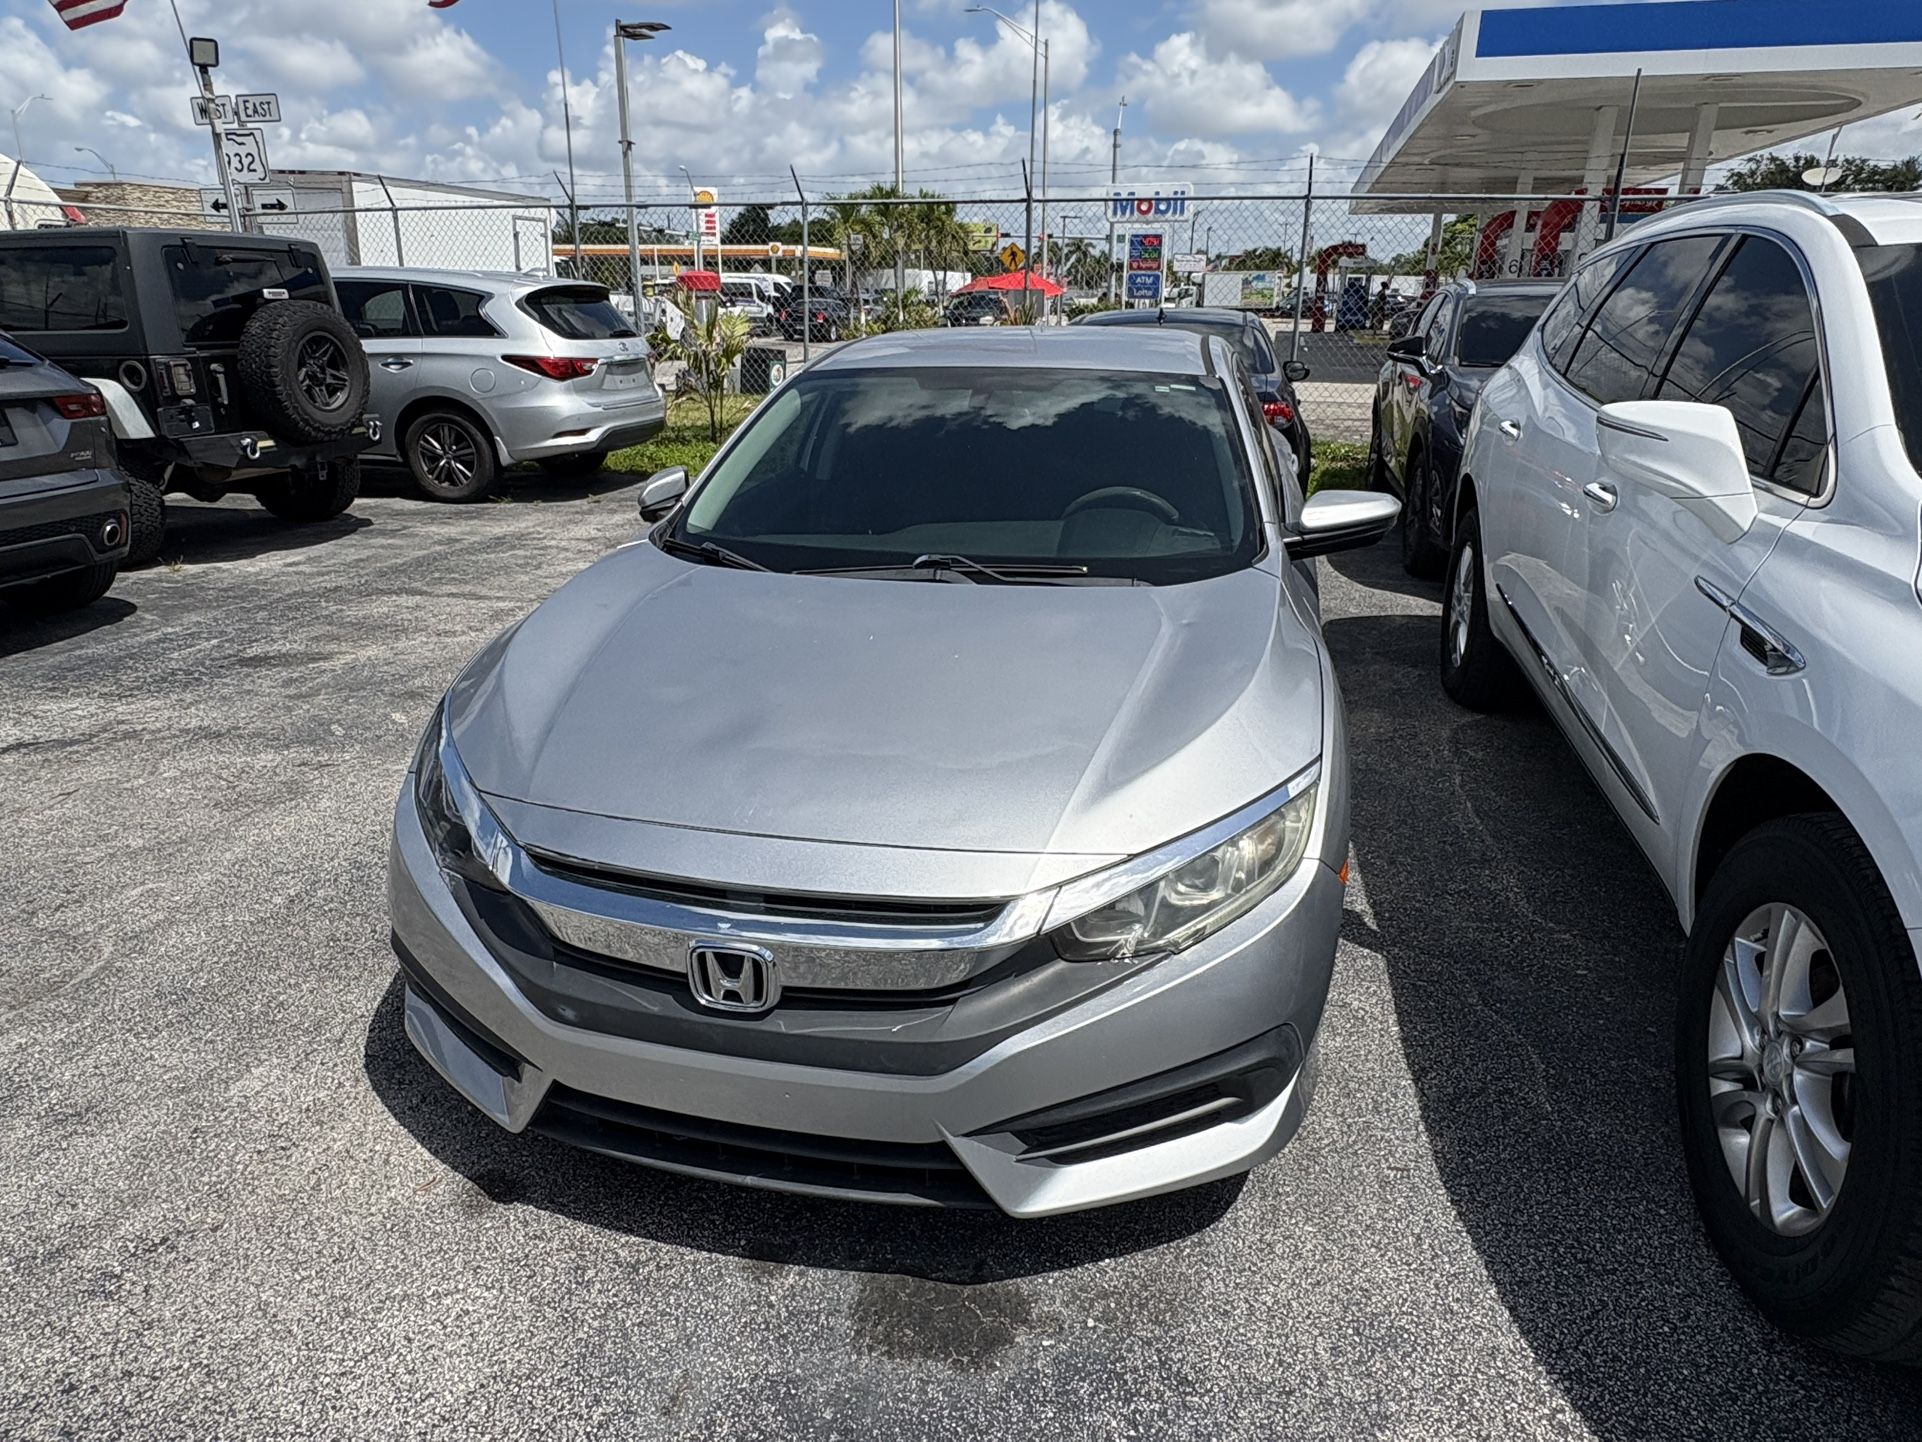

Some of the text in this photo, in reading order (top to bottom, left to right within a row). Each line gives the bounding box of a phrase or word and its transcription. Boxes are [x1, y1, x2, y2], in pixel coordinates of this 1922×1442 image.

[196, 102, 228, 120] WST
[242, 100, 273, 118] EAST
[1112, 190, 1186, 217] Mobil
[1508, 259, 1520, 275] 6
[1135, 276, 1154, 284] ATM
